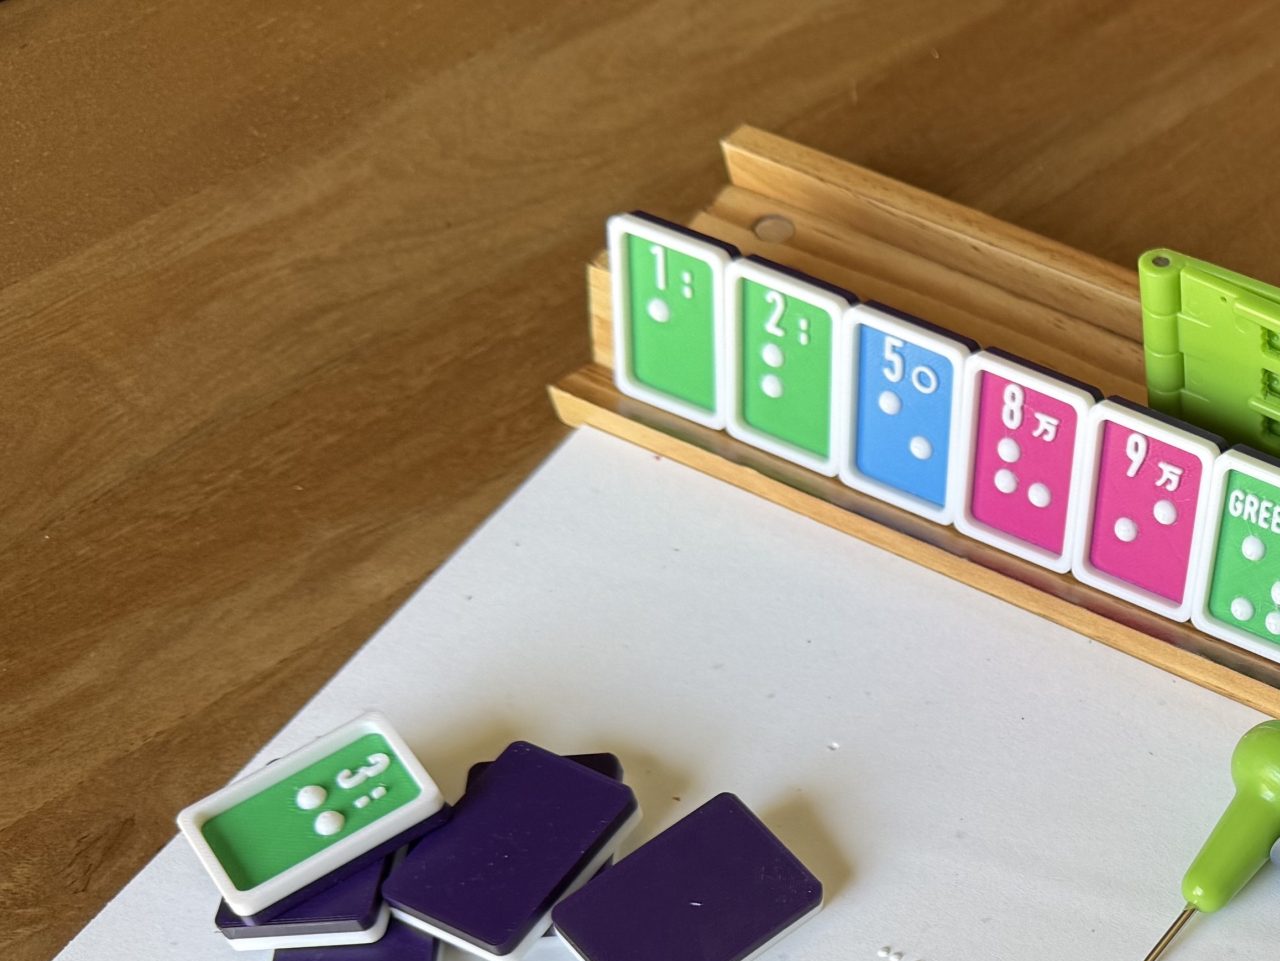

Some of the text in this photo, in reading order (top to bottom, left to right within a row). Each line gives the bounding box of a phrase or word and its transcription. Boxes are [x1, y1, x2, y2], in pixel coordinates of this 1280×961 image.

[650, 244, 666, 290] 1
[764, 290, 785, 337] 2
[882, 337, 904, 383] 5
[1001, 384, 1024, 429] 8
[1125, 432, 1148, 478] 9
[336, 752, 391, 790] 3
